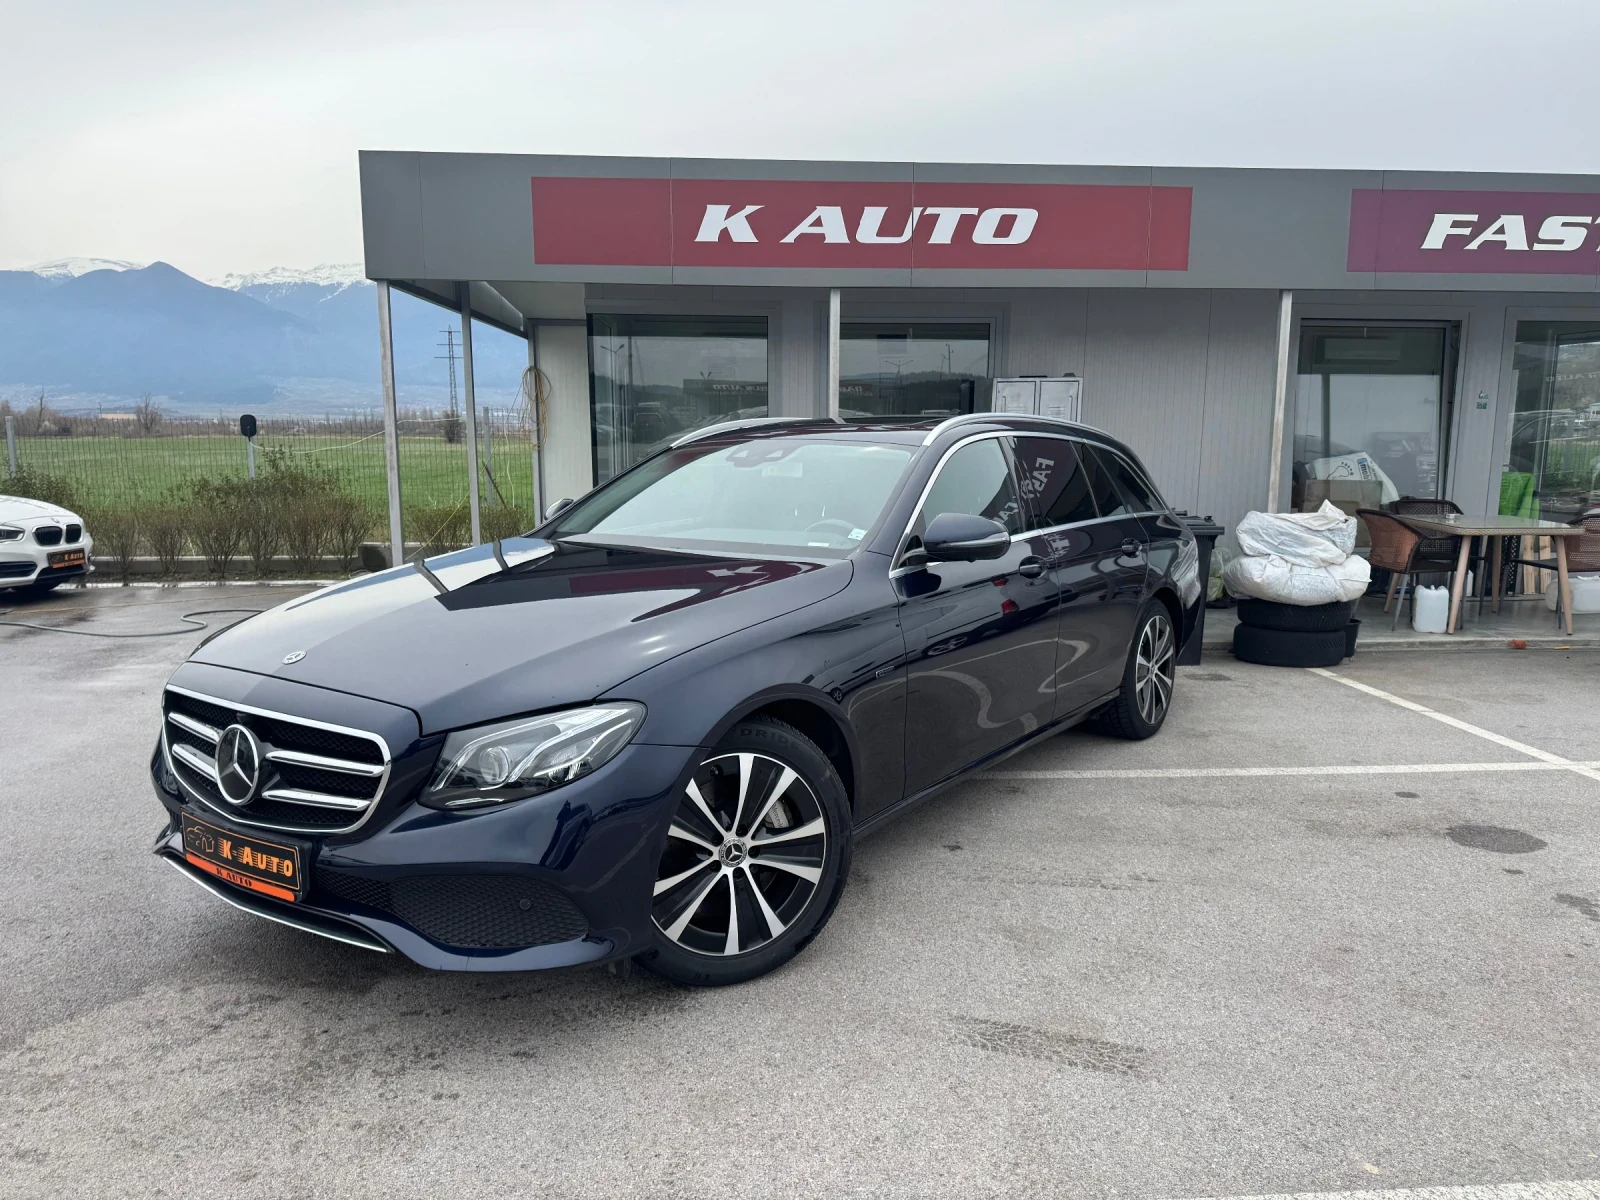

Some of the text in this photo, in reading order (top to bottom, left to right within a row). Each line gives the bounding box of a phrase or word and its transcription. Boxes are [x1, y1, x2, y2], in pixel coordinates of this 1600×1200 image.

[694, 204, 1039, 245] K AUTO
[1420, 213, 1600, 252] FAS
[216, 867, 253, 887] K AUTO
[240, 846, 293, 877] AUTO
